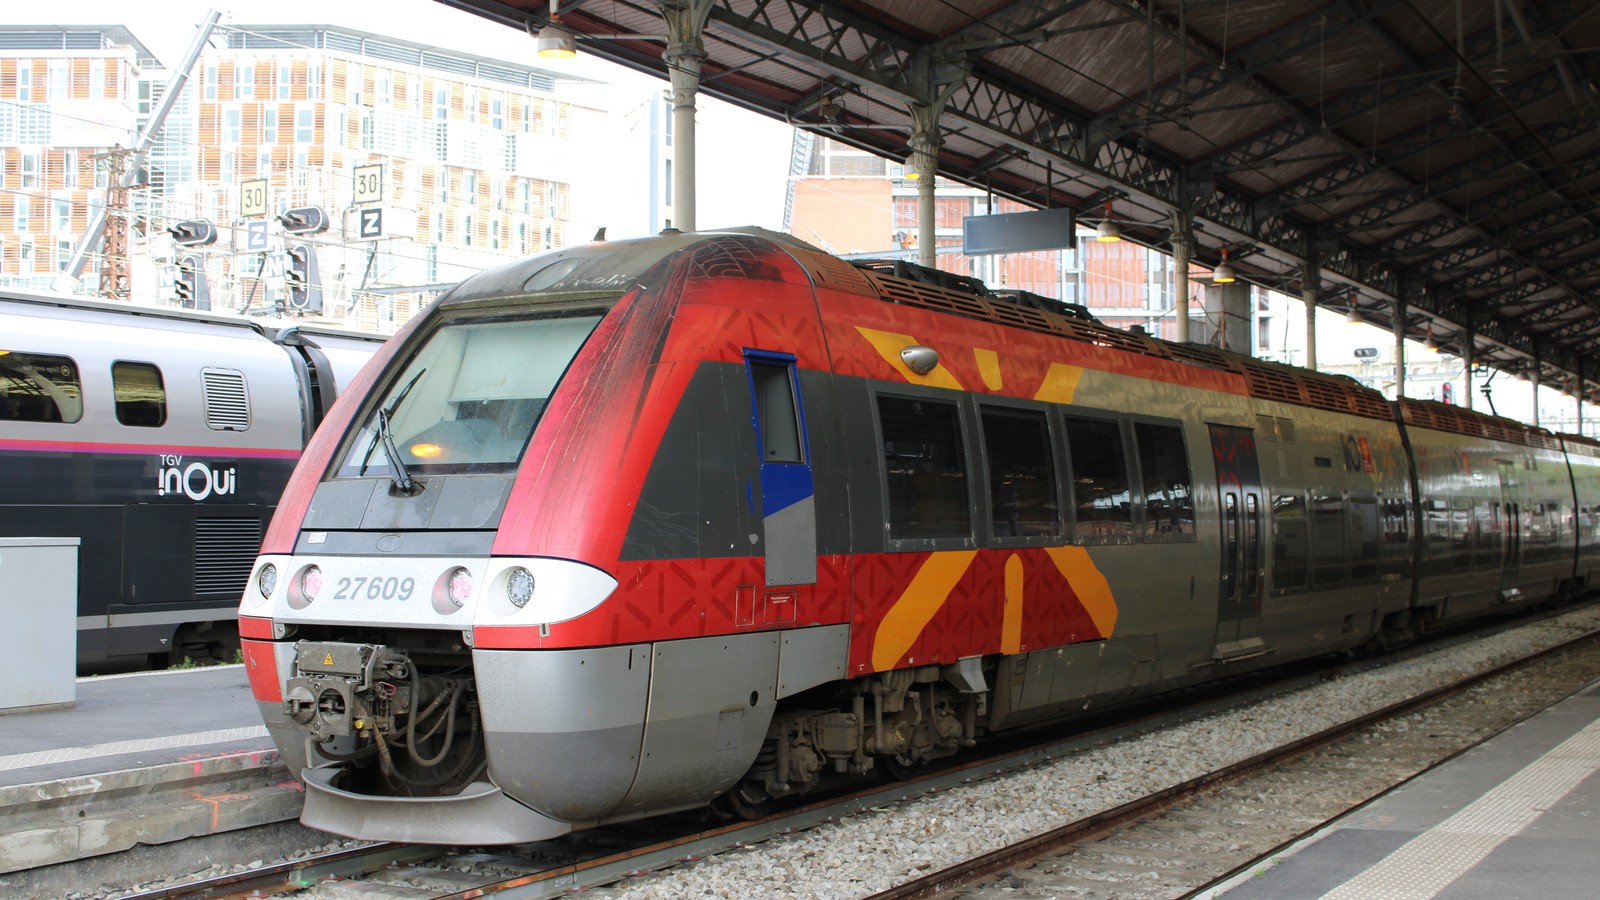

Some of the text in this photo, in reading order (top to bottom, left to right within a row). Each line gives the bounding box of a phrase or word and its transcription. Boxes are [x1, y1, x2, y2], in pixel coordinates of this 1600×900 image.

[358, 173, 378, 195] 30
[245, 188, 263, 208] 30
[364, 212, 380, 235] Z
[251, 225, 266, 247] Z
[160, 454, 182, 466] TGV
[333, 576, 416, 601] 27609
